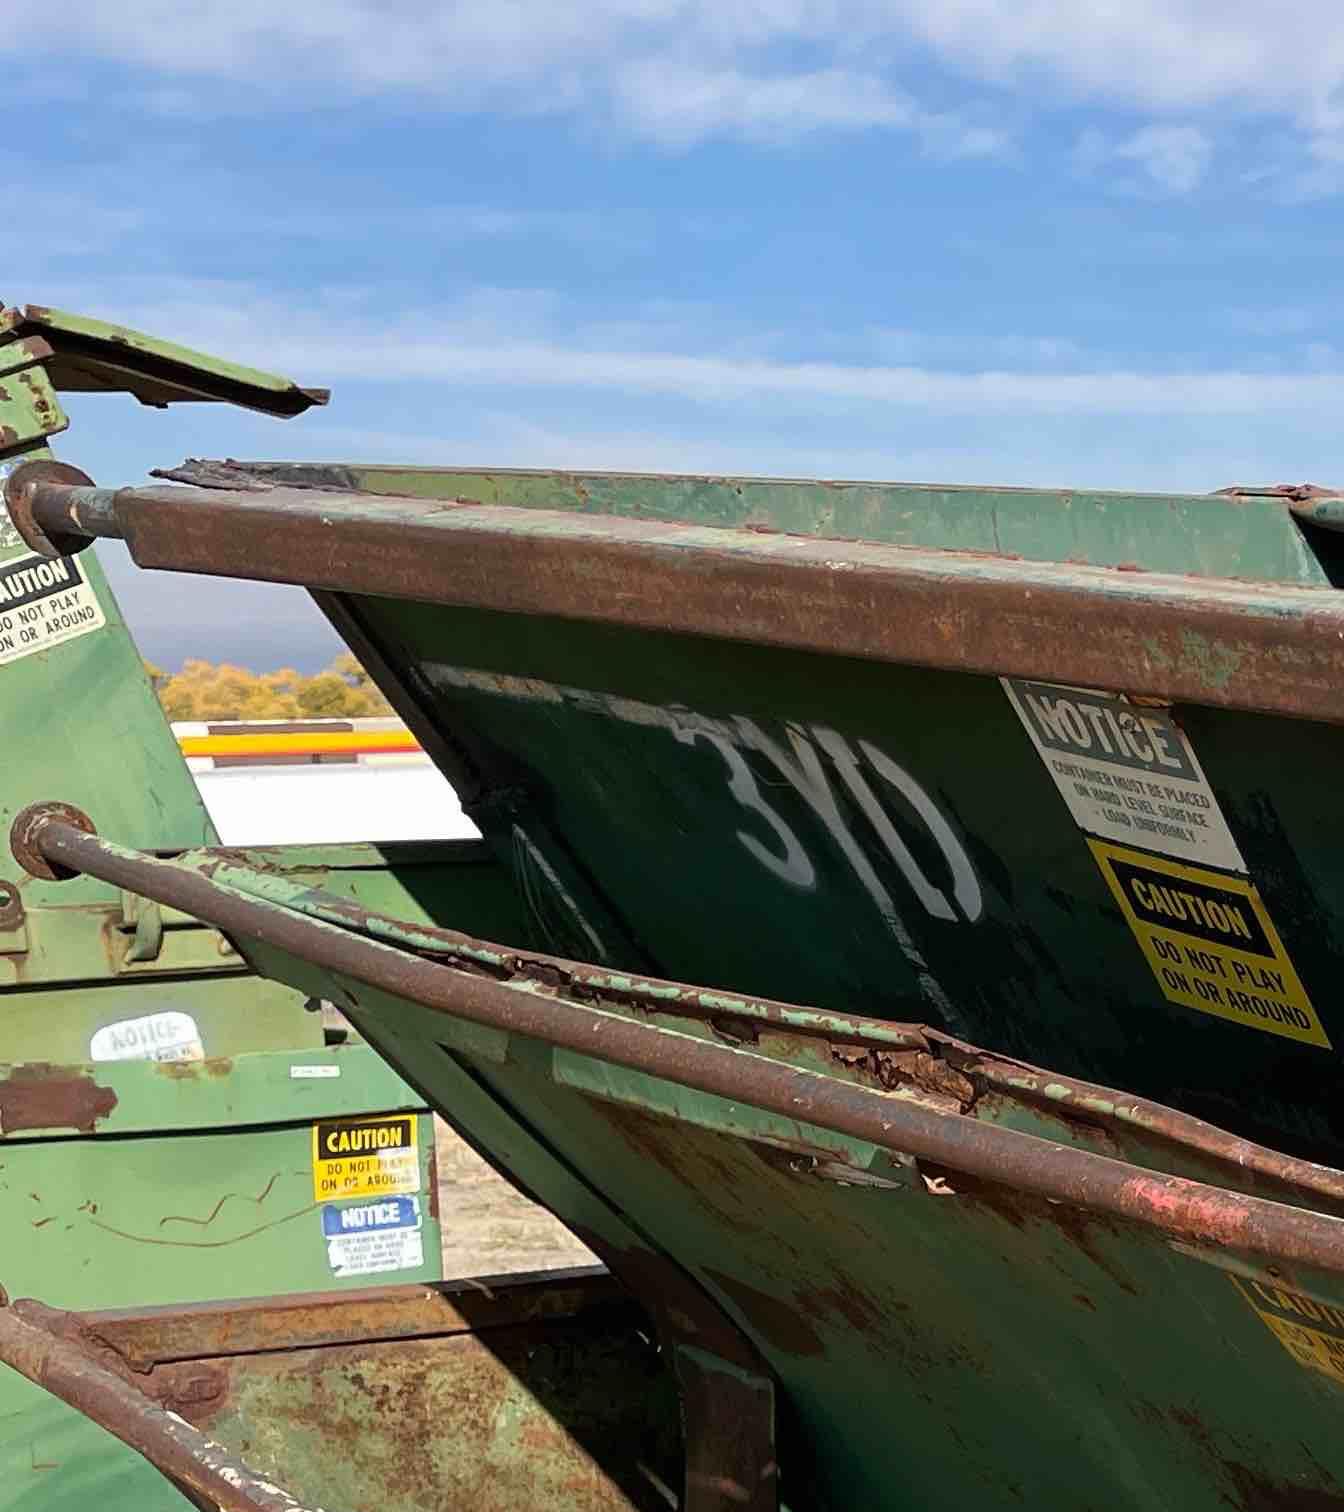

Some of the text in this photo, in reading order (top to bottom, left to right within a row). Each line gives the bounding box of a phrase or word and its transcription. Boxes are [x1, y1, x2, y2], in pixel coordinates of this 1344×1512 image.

[0, 558, 70, 604] AUTION
[18, 605, 43, 625] NOT
[50, 591, 80, 613] PLAY
[20, 626, 38, 643] OR
[46, 605, 95, 634] AROUND
[1024, 694, 1182, 769] NOTICE
[1130, 878, 1253, 940] CAUTION
[1151, 936, 1287, 995] DO NOT PLAY
[1162, 967, 1312, 1030] ON OR AROUND
[326, 1127, 402, 1153] CAUTION
[321, 1178, 337, 1191] ON
[327, 1163, 342, 1175] DO
[341, 1202, 400, 1229] NOTICE
